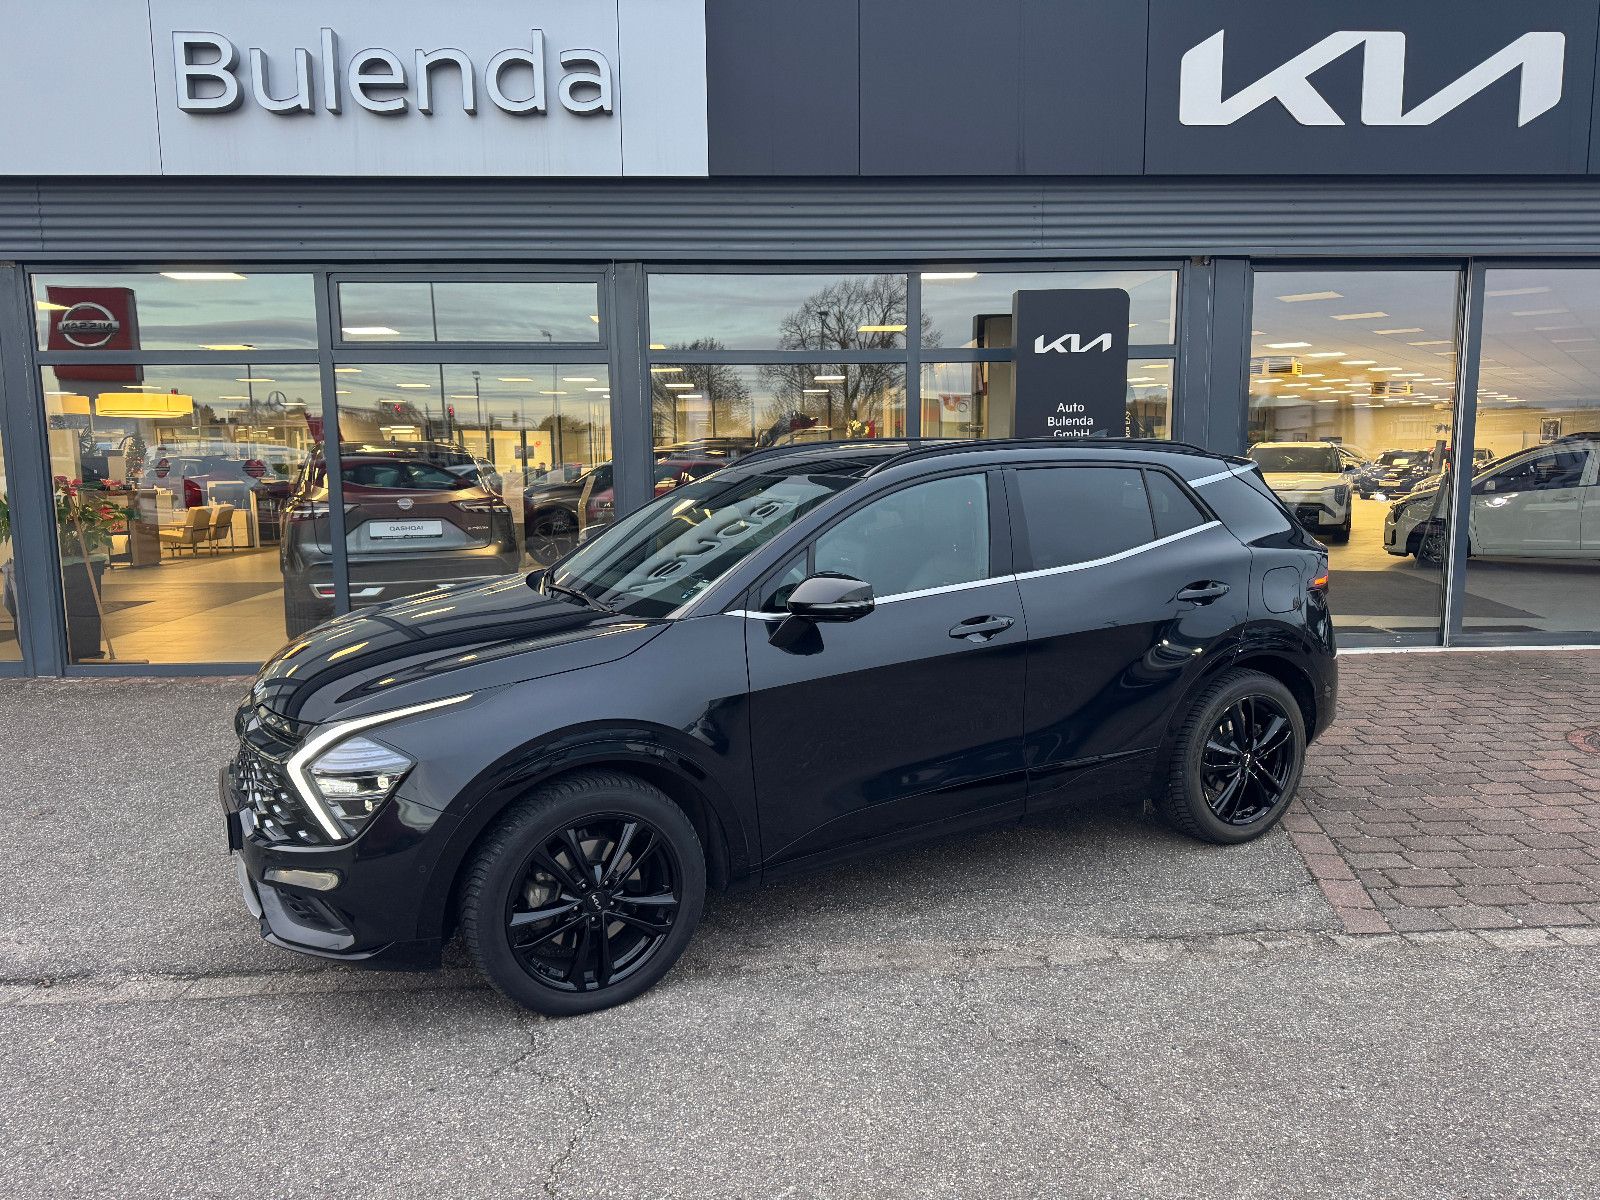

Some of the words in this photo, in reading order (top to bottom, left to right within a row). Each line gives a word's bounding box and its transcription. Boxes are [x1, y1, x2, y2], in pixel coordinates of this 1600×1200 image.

[172, 27, 614, 115] Bulenda
[1179, 29, 1566, 128] KIA
[1034, 333, 1112, 354] KIA
[1056, 402, 1085, 413] Auto
[1047, 416, 1094, 427] Bulenda
[1053, 428, 1090, 437] GmbH
